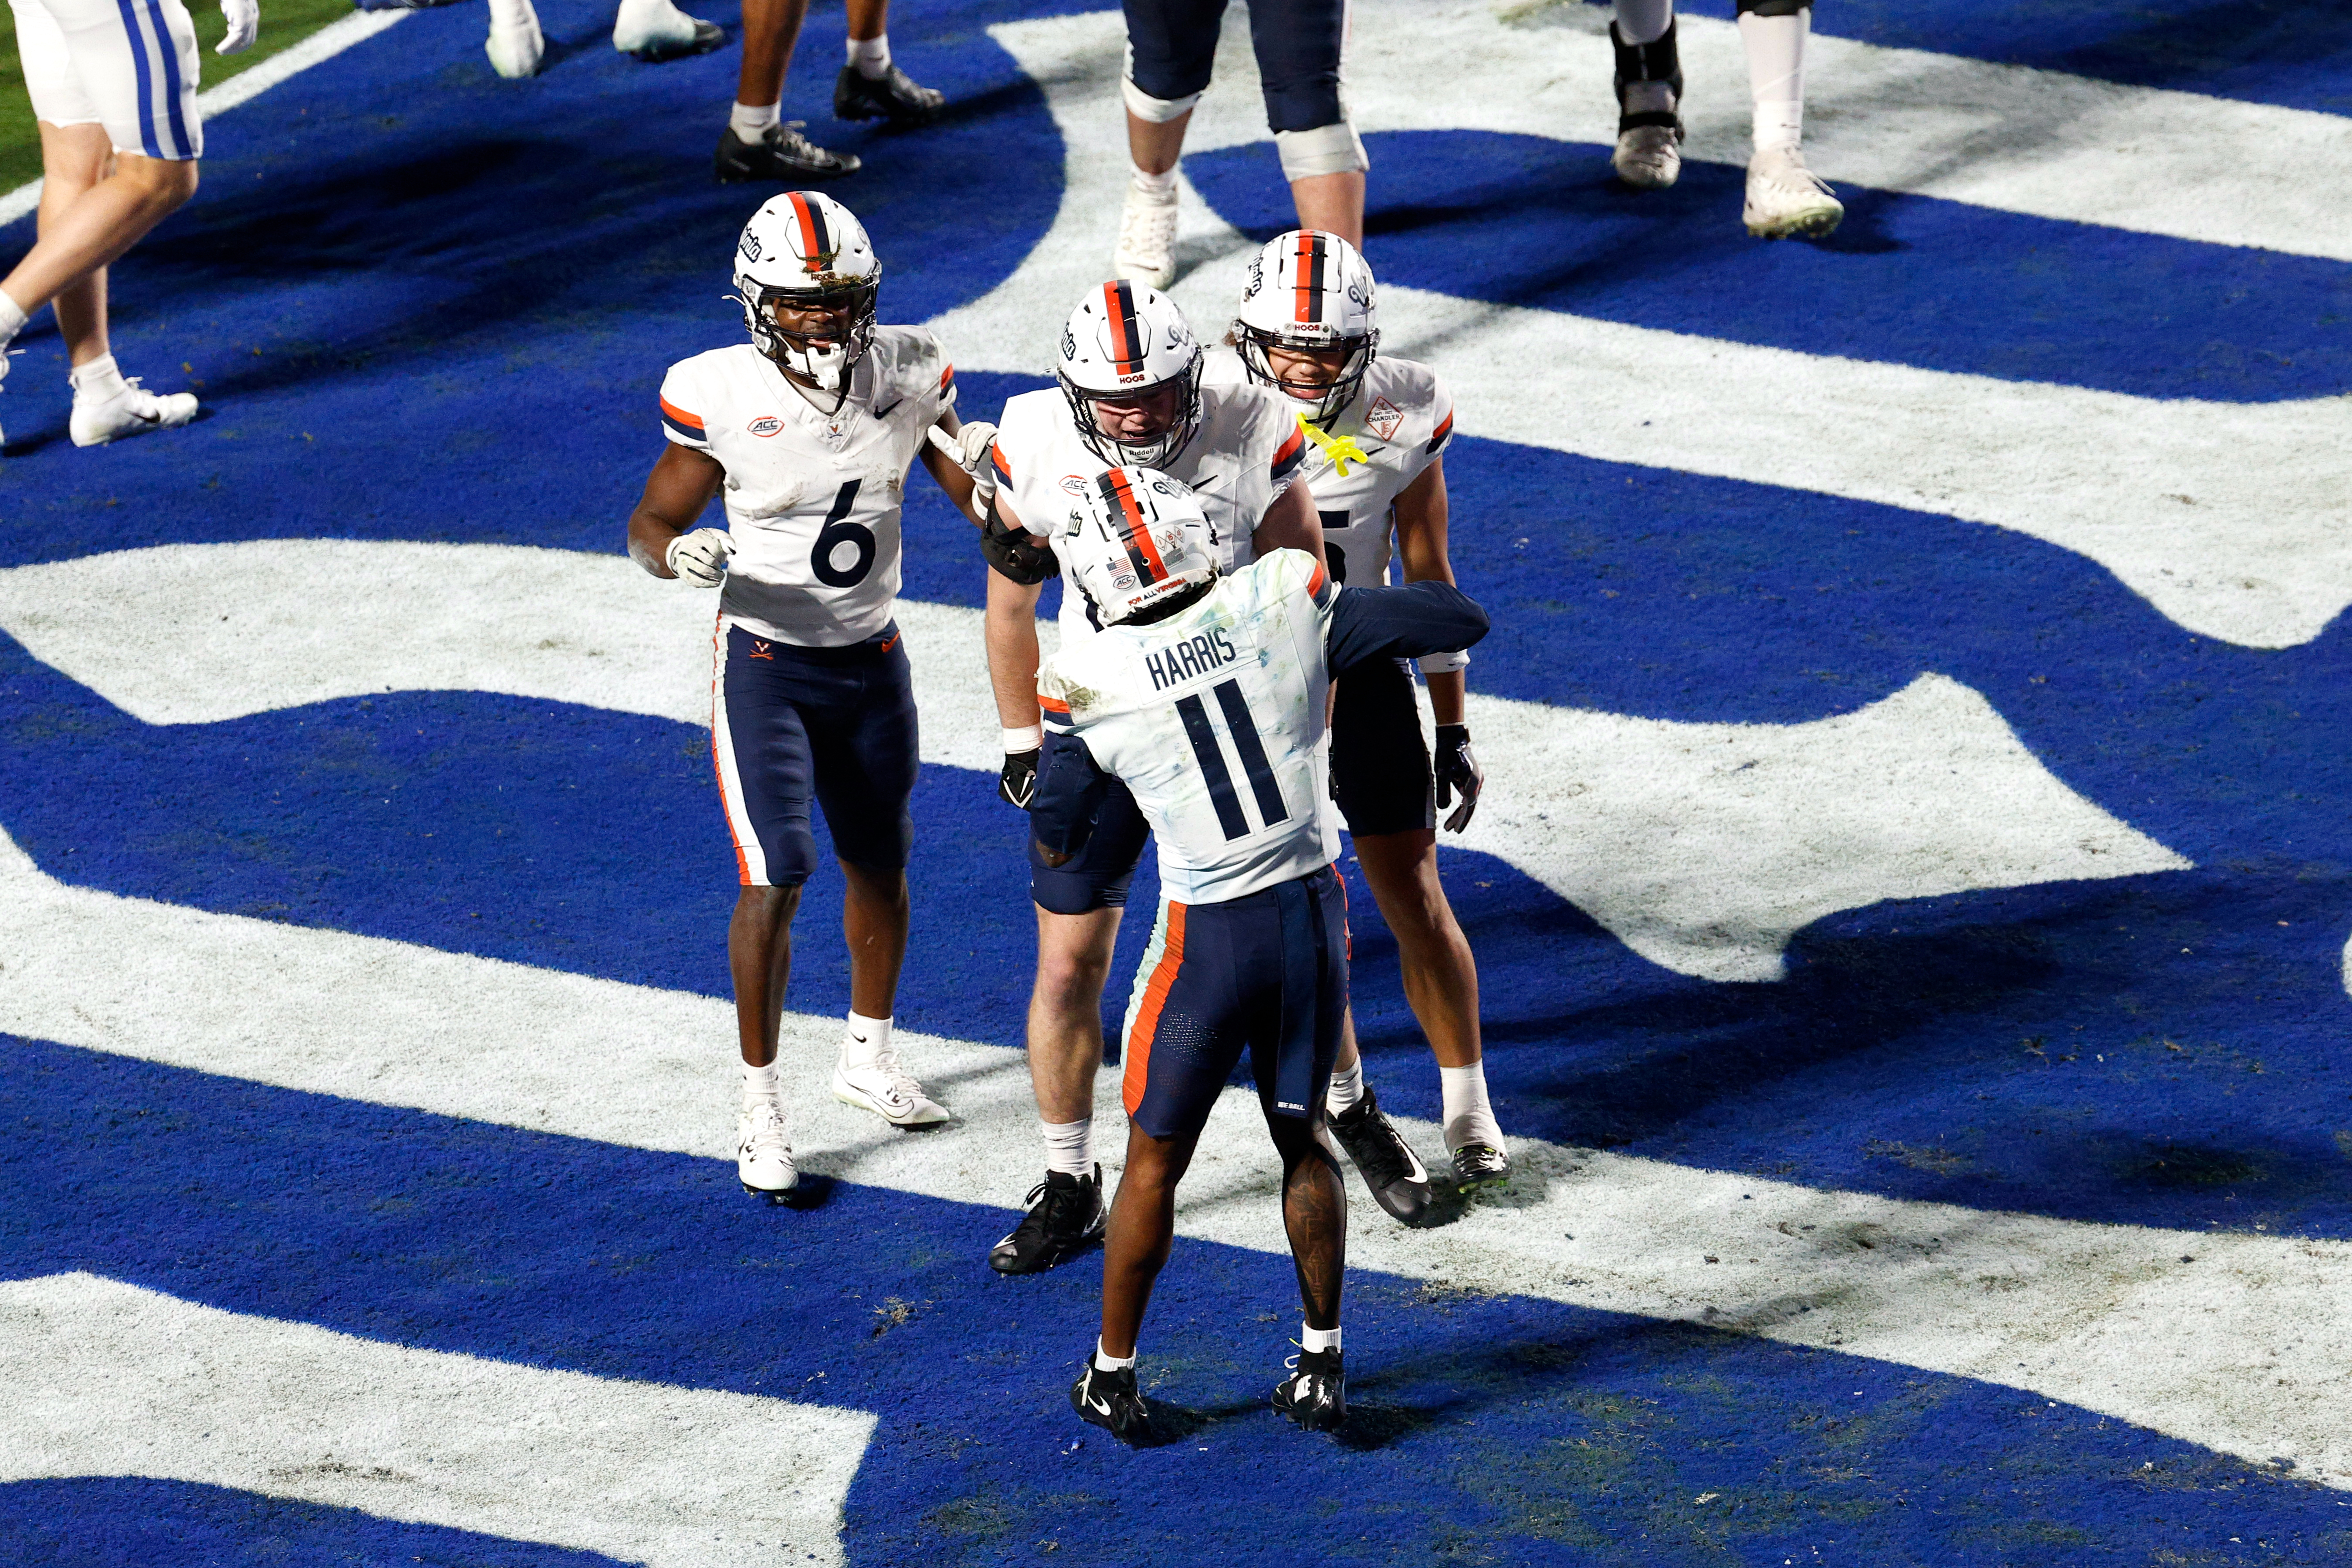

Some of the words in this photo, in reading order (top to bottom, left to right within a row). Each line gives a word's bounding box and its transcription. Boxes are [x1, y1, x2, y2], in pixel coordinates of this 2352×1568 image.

[1119, 374, 1145, 384] HOOS
[1368, 414, 1400, 422] CHANDLER
[753, 420, 778, 430] ACC
[1064, 480, 1088, 488] ACC
[811, 478, 876, 588] 6
[1117, 576, 1132, 586] ACC
[1128, 596, 1143, 606] FOR
[1144, 590, 1157, 600] ALL
[1154, 577, 1187, 593] VIRGINIA
[1145, 627, 1236, 691] HARRIS
[1174, 677, 1289, 841] 11
